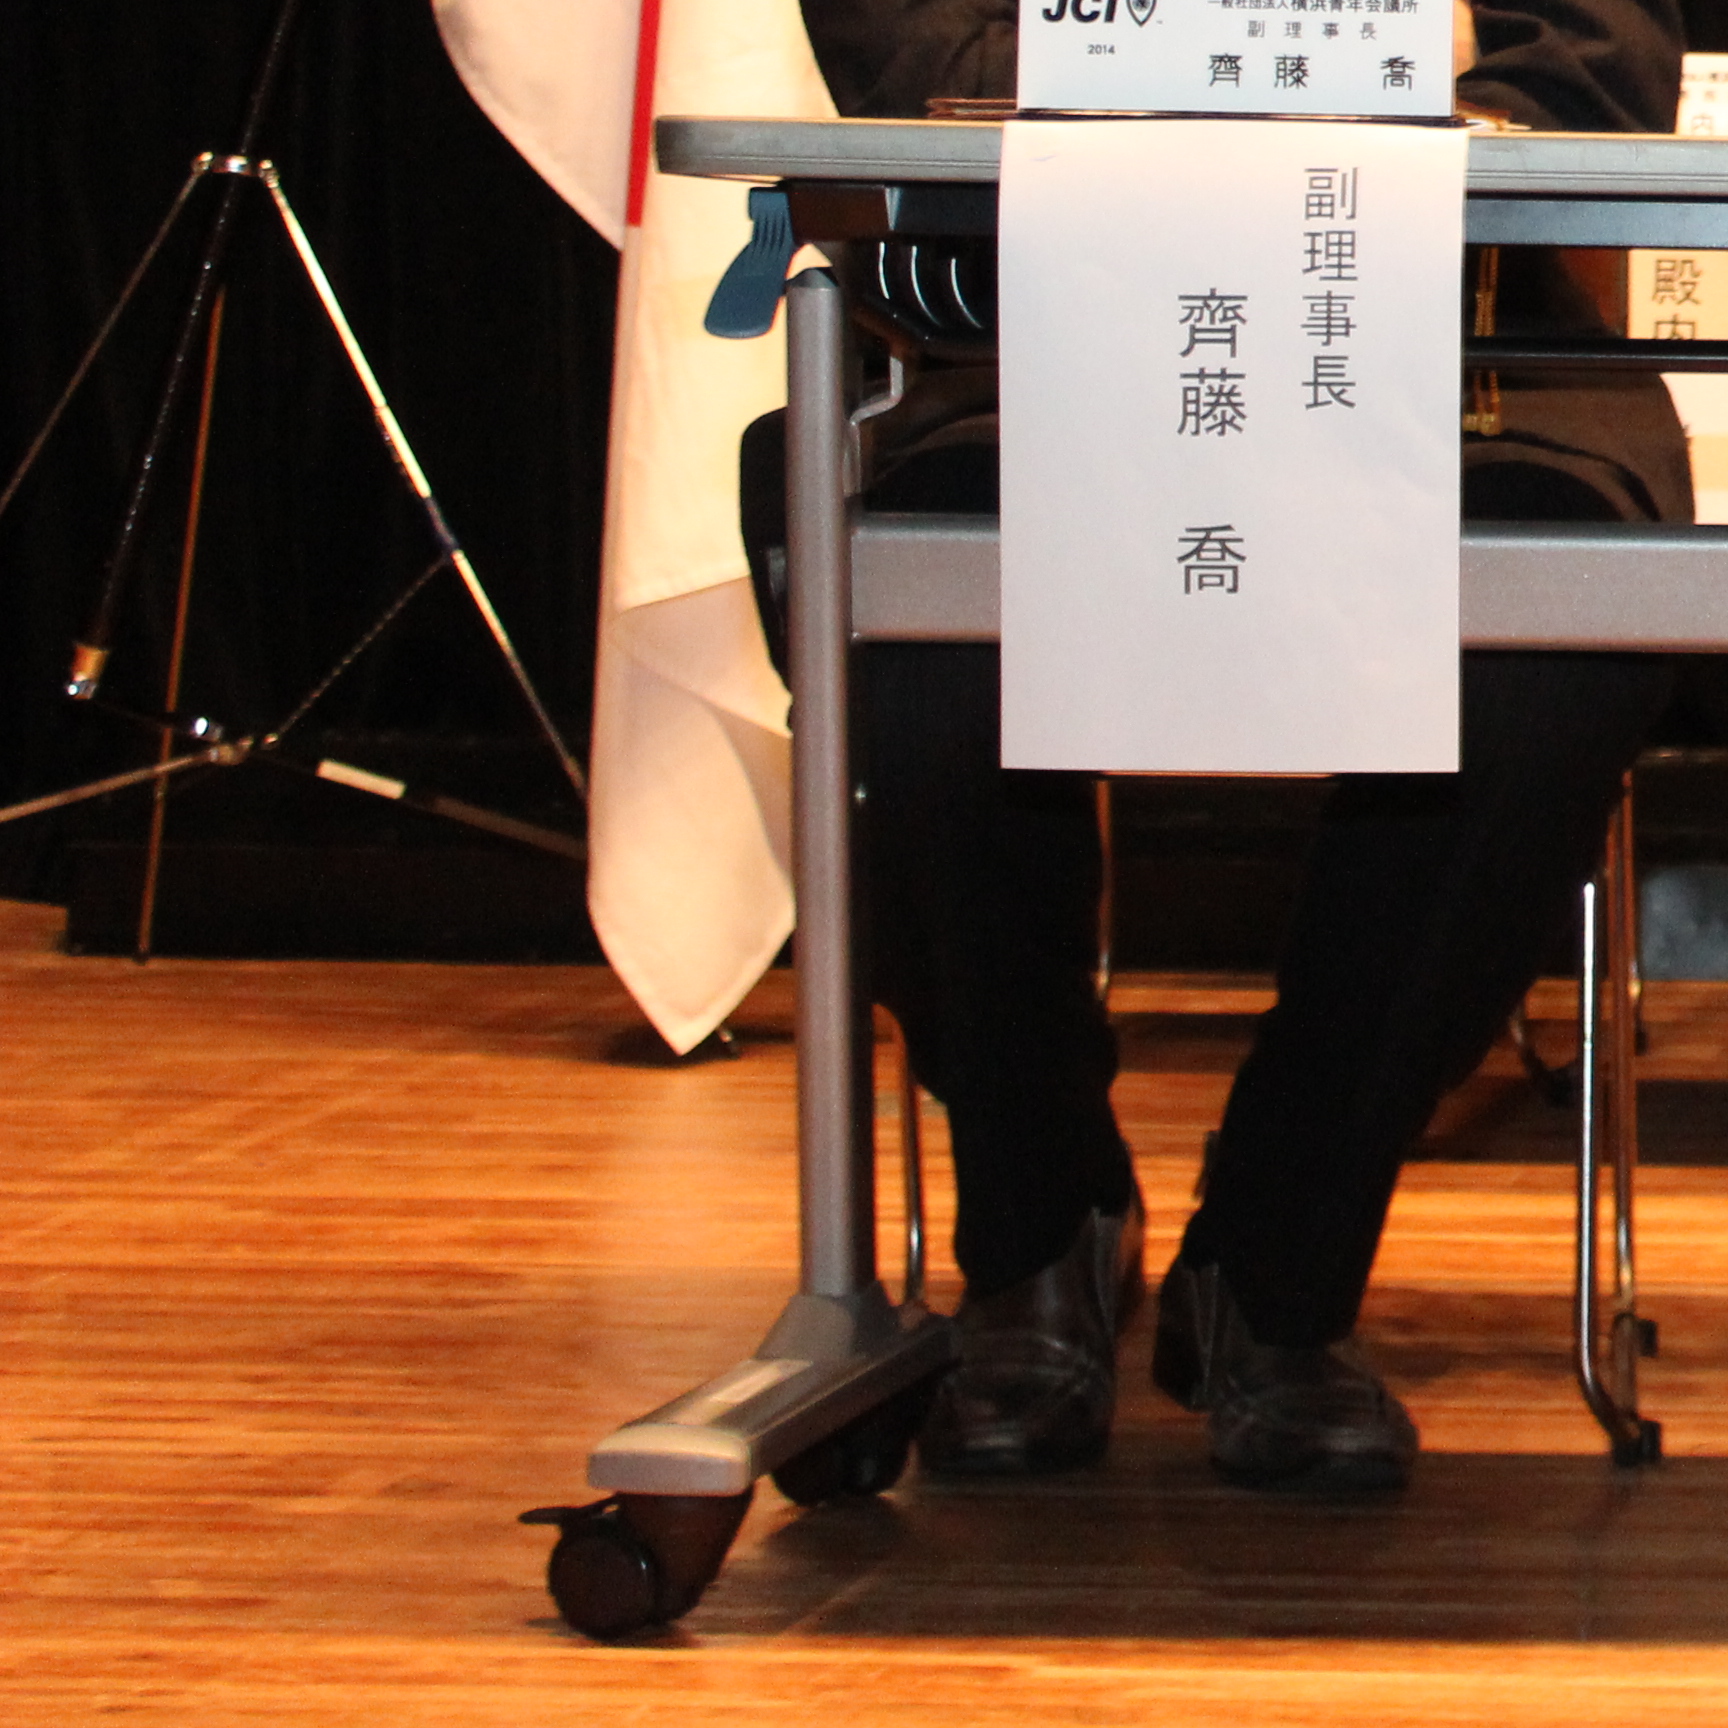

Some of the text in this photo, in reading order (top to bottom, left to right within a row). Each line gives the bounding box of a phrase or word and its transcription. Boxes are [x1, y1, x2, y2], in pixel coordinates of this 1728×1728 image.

[1087, 44, 1116, 56] 2014
[1247, 20, 1378, 41] 副理事長
[1300, 166, 1360, 411] 副理事長
[1175, 523, 1250, 597] 喬
